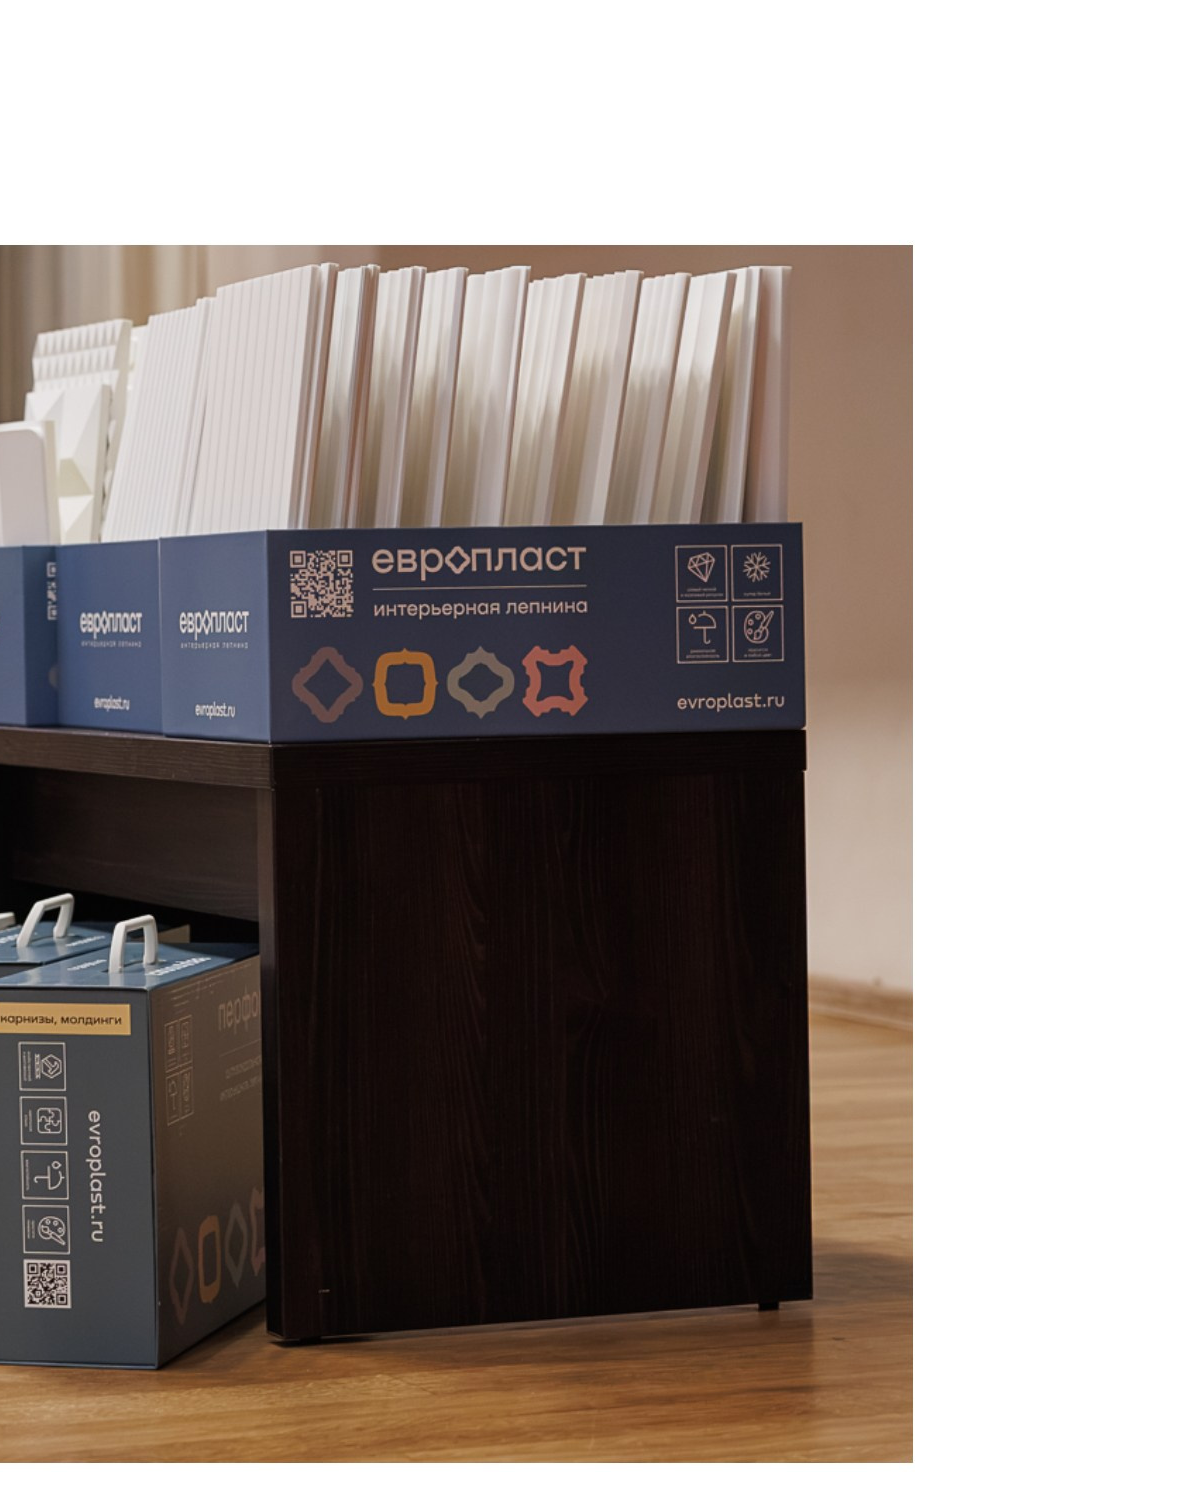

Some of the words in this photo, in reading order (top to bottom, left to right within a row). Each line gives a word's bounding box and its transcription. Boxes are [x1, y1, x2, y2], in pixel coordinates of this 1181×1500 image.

[372, 545, 587, 581] европласт
[373, 600, 501, 620] интерьерная
[505, 599, 588, 615] лепнина
[79, 611, 143, 639] европласт
[179, 609, 250, 640] европласт
[93, 694, 130, 712] evroplast.ru
[195, 701, 236, 720] evroplast.ru
[677, 692, 785, 713] evroplast.ru
[0, 1014, 57, 1026] карнизы,
[60, 1016, 122, 1026] молдинги
[85, 1109, 106, 1243] evroplast.ru
